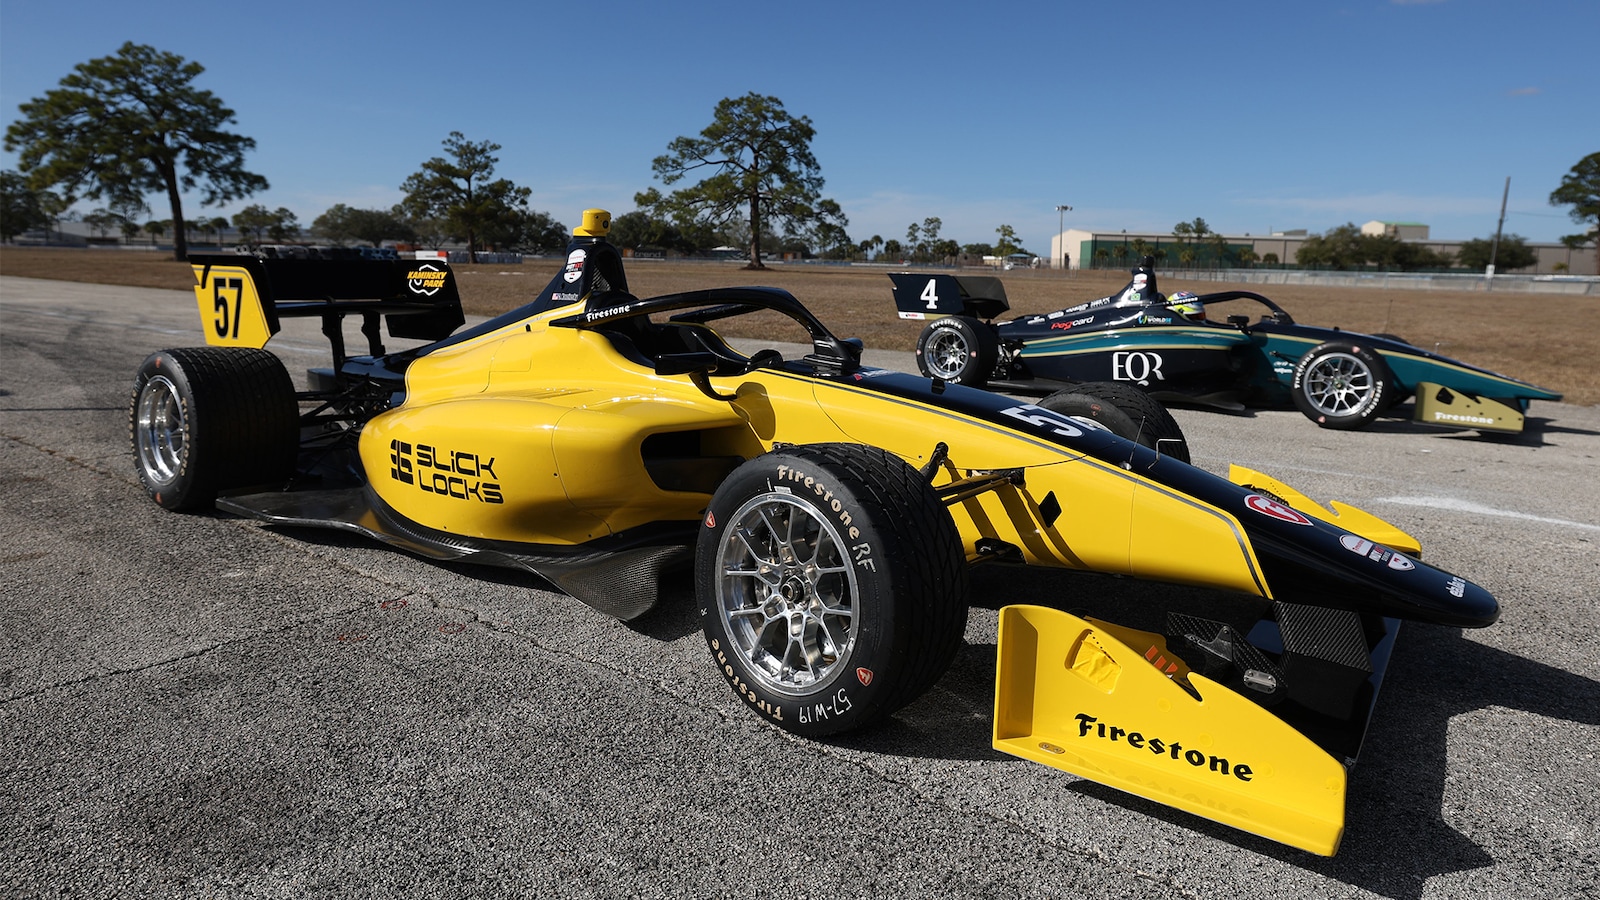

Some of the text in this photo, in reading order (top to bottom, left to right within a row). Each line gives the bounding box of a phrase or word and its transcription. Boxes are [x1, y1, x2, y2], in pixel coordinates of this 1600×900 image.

[407, 271, 447, 279] KAMINSKY
[423, 280, 445, 288] PARK
[213, 276, 243, 339] 57
[920, 279, 939, 309] 4
[586, 304, 631, 322] Firestone
[930, 319, 963, 329] Firestone
[1112, 351, 1165, 387] EQR
[1434, 411, 1495, 425] Firestone
[418, 468, 505, 505] LOCKS
[777, 464, 861, 541] Firestone
[852, 542, 877, 573] RF
[711, 638, 784, 721] Firestone
[1074, 713, 1254, 782] Firestone
